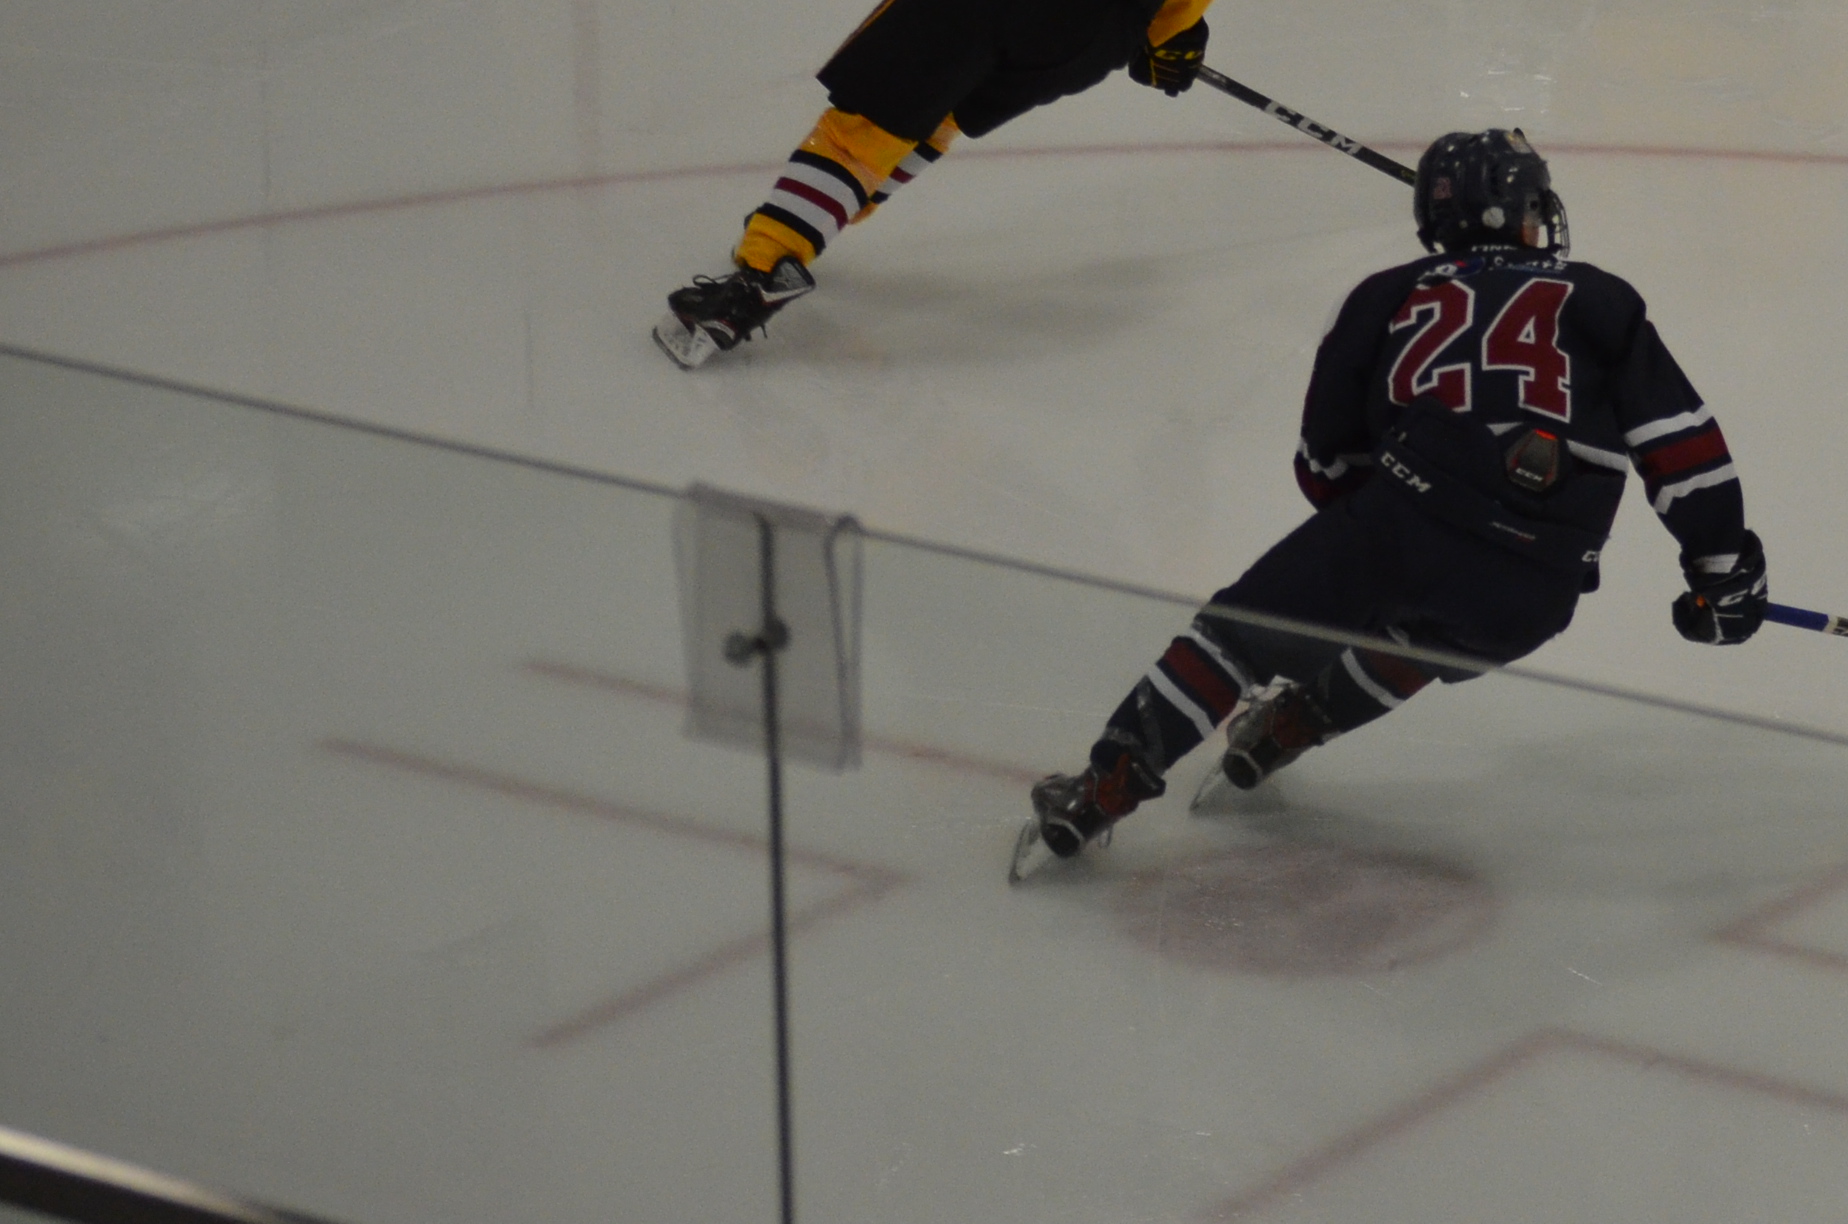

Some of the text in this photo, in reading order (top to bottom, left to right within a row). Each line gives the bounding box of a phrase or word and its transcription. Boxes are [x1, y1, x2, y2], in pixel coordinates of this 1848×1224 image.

[1264, 100, 1364, 156] CCM
[1388, 276, 1574, 423] 24
[1380, 450, 1432, 494] CCM
